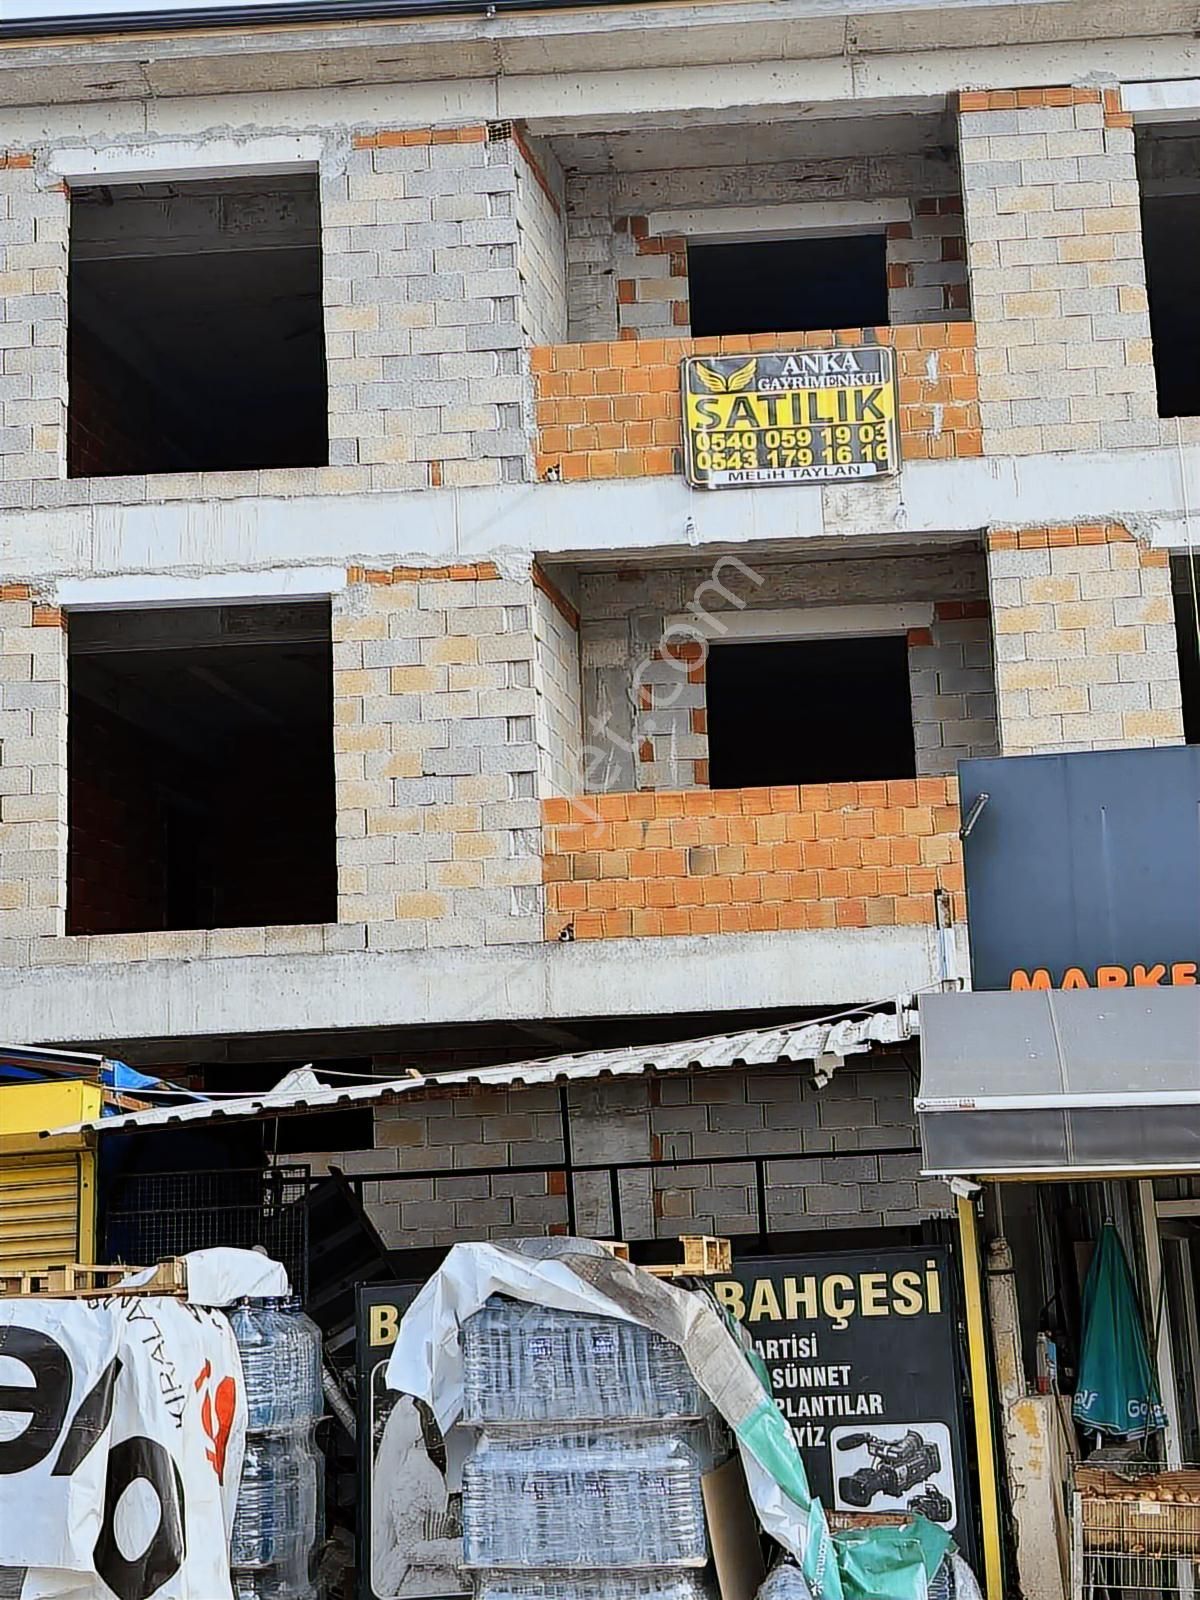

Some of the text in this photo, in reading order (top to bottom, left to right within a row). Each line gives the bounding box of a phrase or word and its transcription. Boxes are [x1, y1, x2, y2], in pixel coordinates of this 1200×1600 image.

[781, 352, 861, 376] ANKA
[695, 387, 886, 430] SATILIK
[696, 423, 886, 452] 0540 059 19 03
[697, 443, 888, 471] 0543 179 16 16
[789, 465, 861, 479] TAYLAN
[370, 1259, 942, 1347] B BAHÇESİ
[755, 1332, 818, 1360] ARTİSİ
[772, 1363, 851, 1389] SÜNNET
[773, 1394, 883, 1418] PLANTILAR
[793, 1421, 826, 1447] YİZ
